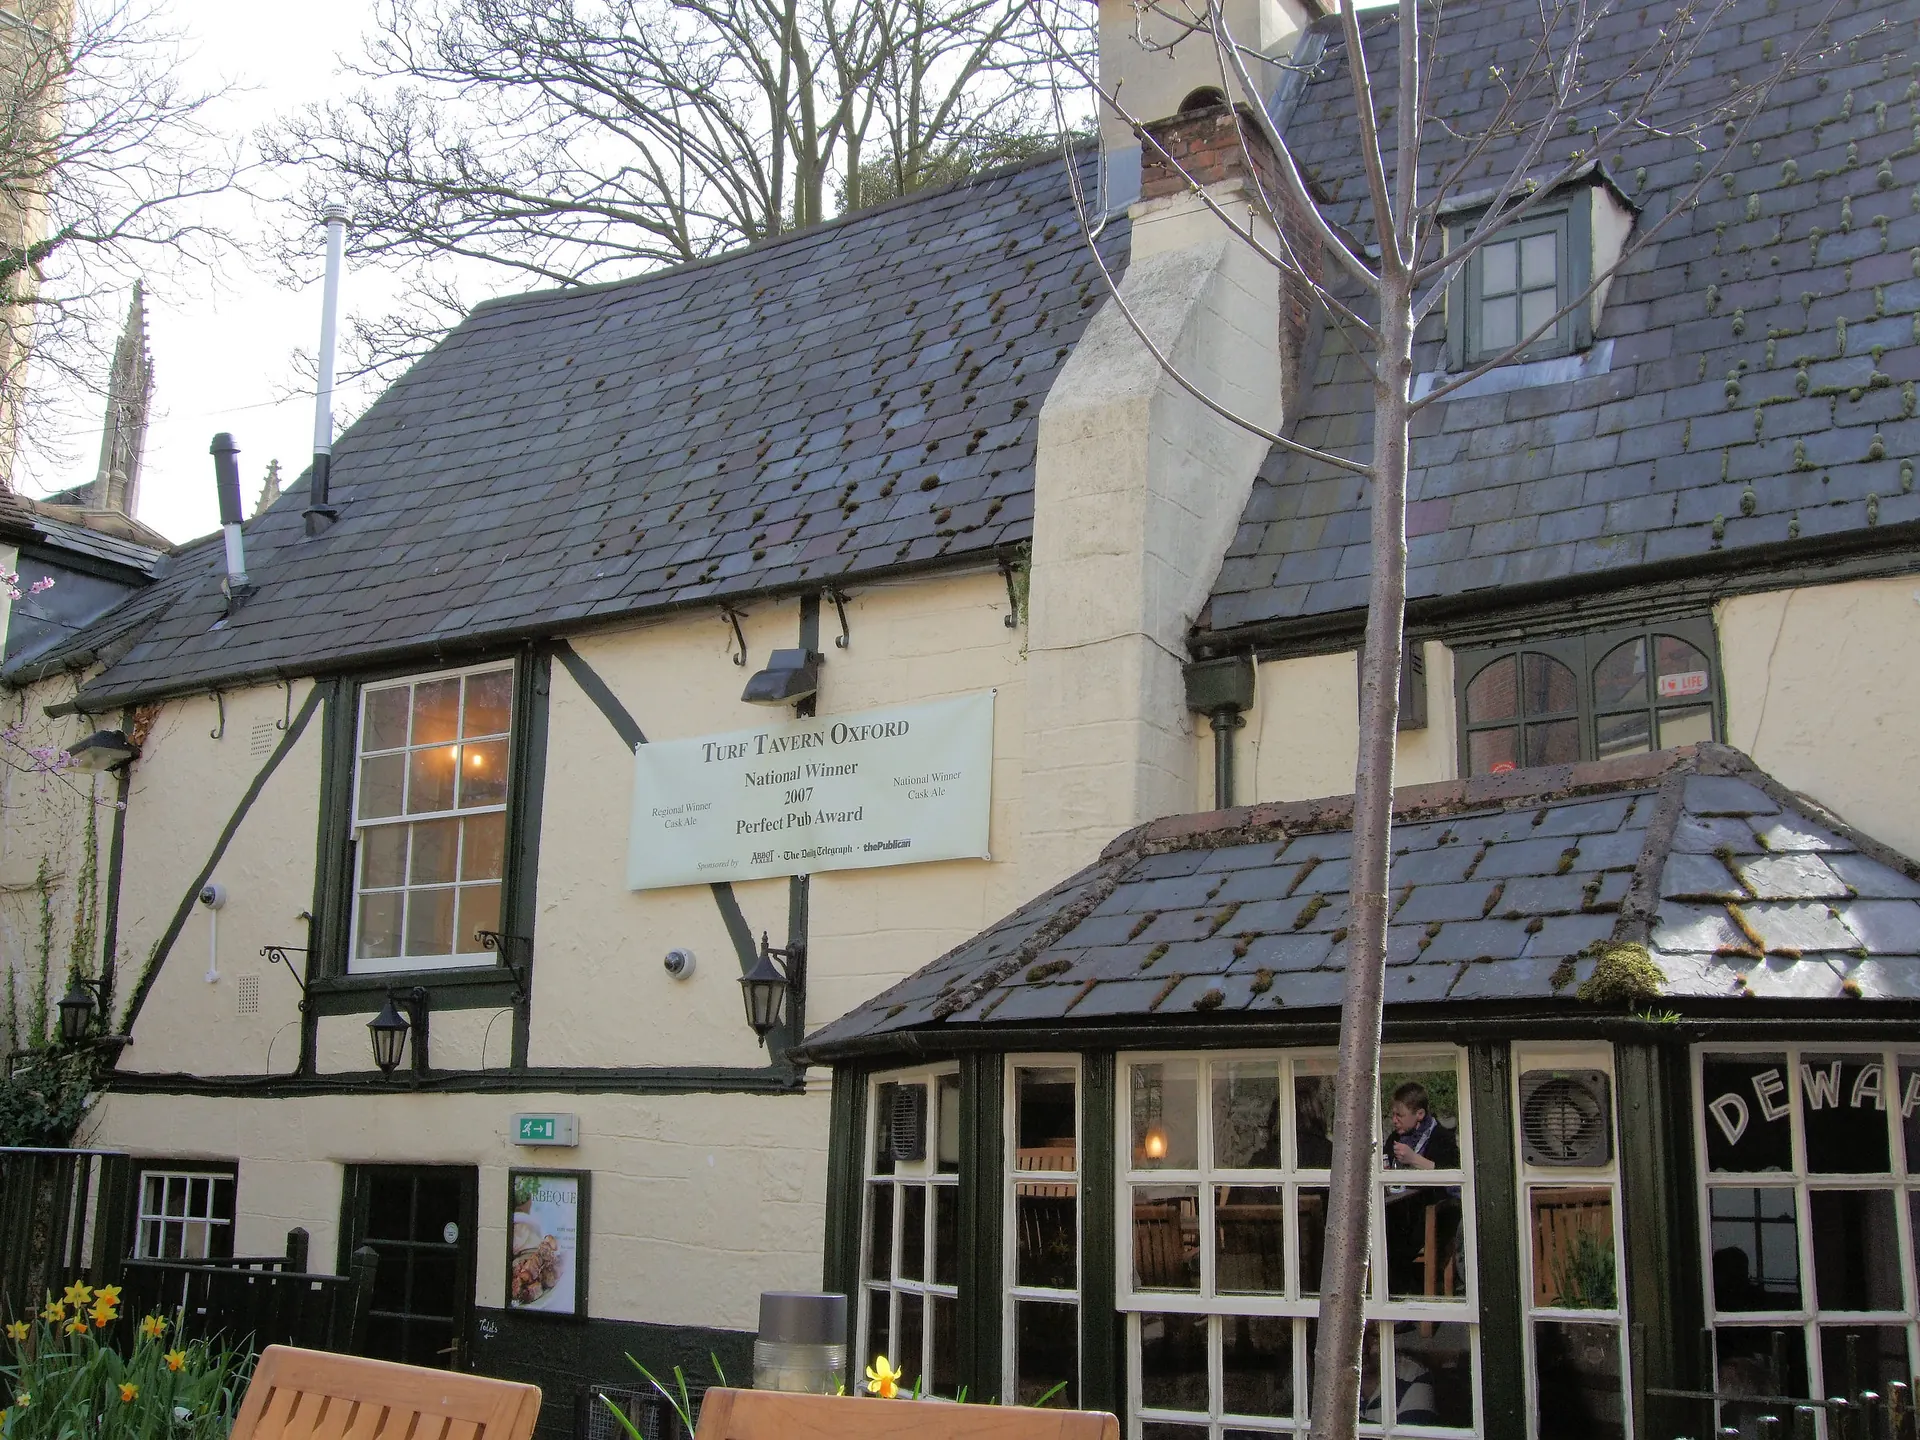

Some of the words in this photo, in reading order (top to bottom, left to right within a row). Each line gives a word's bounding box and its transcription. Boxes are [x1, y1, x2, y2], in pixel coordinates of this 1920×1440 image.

[1682, 675, 1703, 689] LIFE
[702, 742, 748, 763] TURF
[754, 731, 824, 755] TAVERN
[830, 720, 910, 745] OXFORD
[745, 765, 801, 787] National
[805, 762, 859, 778] Winner
[893, 774, 929, 787] National
[931, 771, 962, 782] Winner
[784, 786, 814, 805] 2007
[907, 788, 929, 800] Cask
[930, 786, 946, 797] Ale
[652, 804, 684, 818] Regional
[685, 802, 712, 812] Winner
[664, 818, 683, 828] Cask
[684, 816, 697, 826] Ale
[736, 817, 783, 834] Perfect
[786, 811, 812, 828] Pub
[814, 806, 864, 825] Award
[697, 859, 729, 871] Sponsored
[730, 859, 740, 868] by
[783, 850, 800, 861] The
[816, 844, 853, 857] Telegraph
[531, 1189, 577, 1206] RBEQUE
